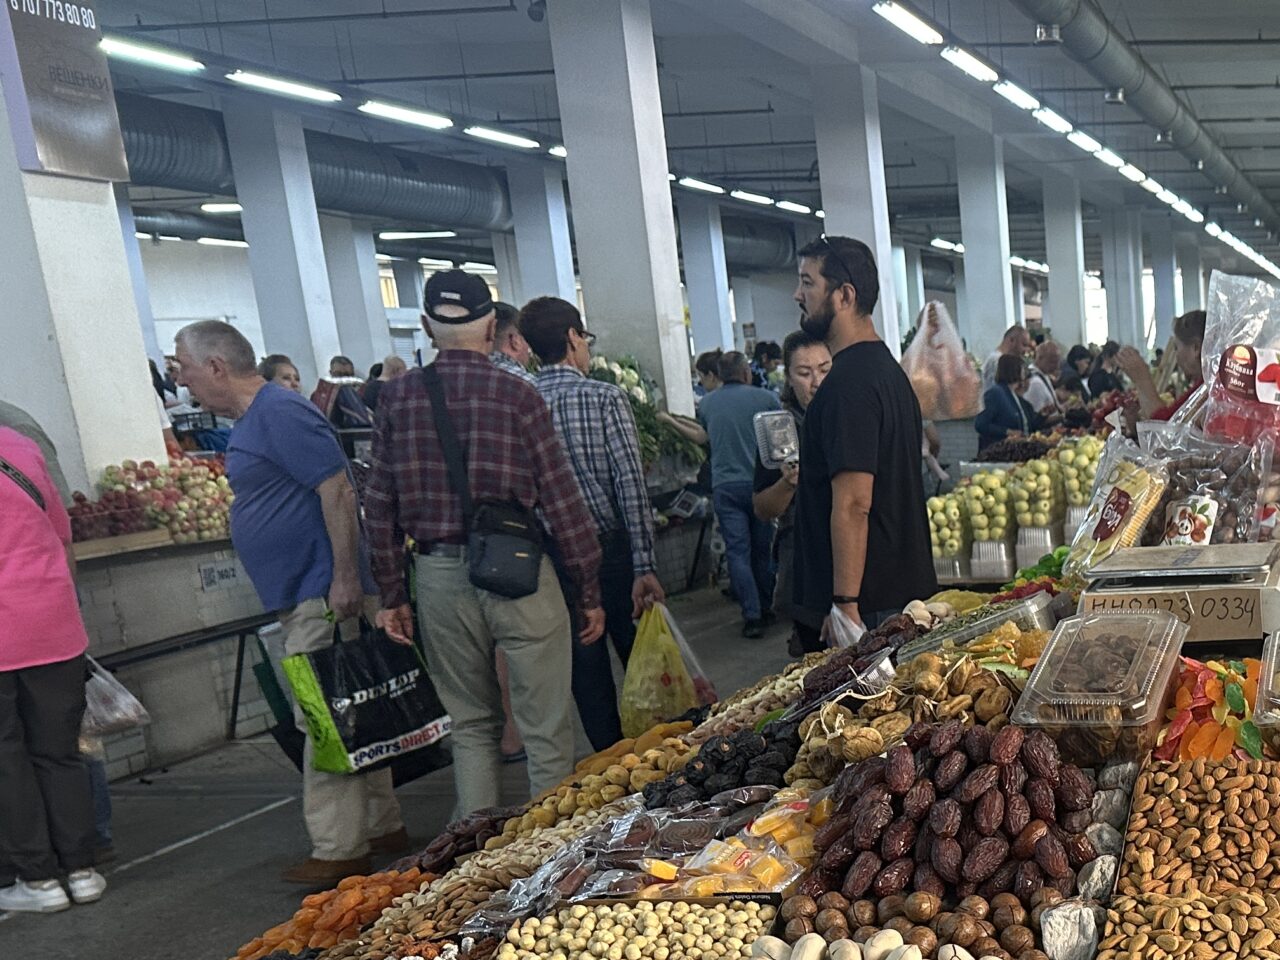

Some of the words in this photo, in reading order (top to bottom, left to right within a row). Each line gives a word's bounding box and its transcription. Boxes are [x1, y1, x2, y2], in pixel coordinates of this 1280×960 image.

[65, 3, 80, 26] 80
[81, 7, 96, 30] 80
[1200, 596, 1256, 628] 0334
[352, 668, 420, 706] DUNLOP
